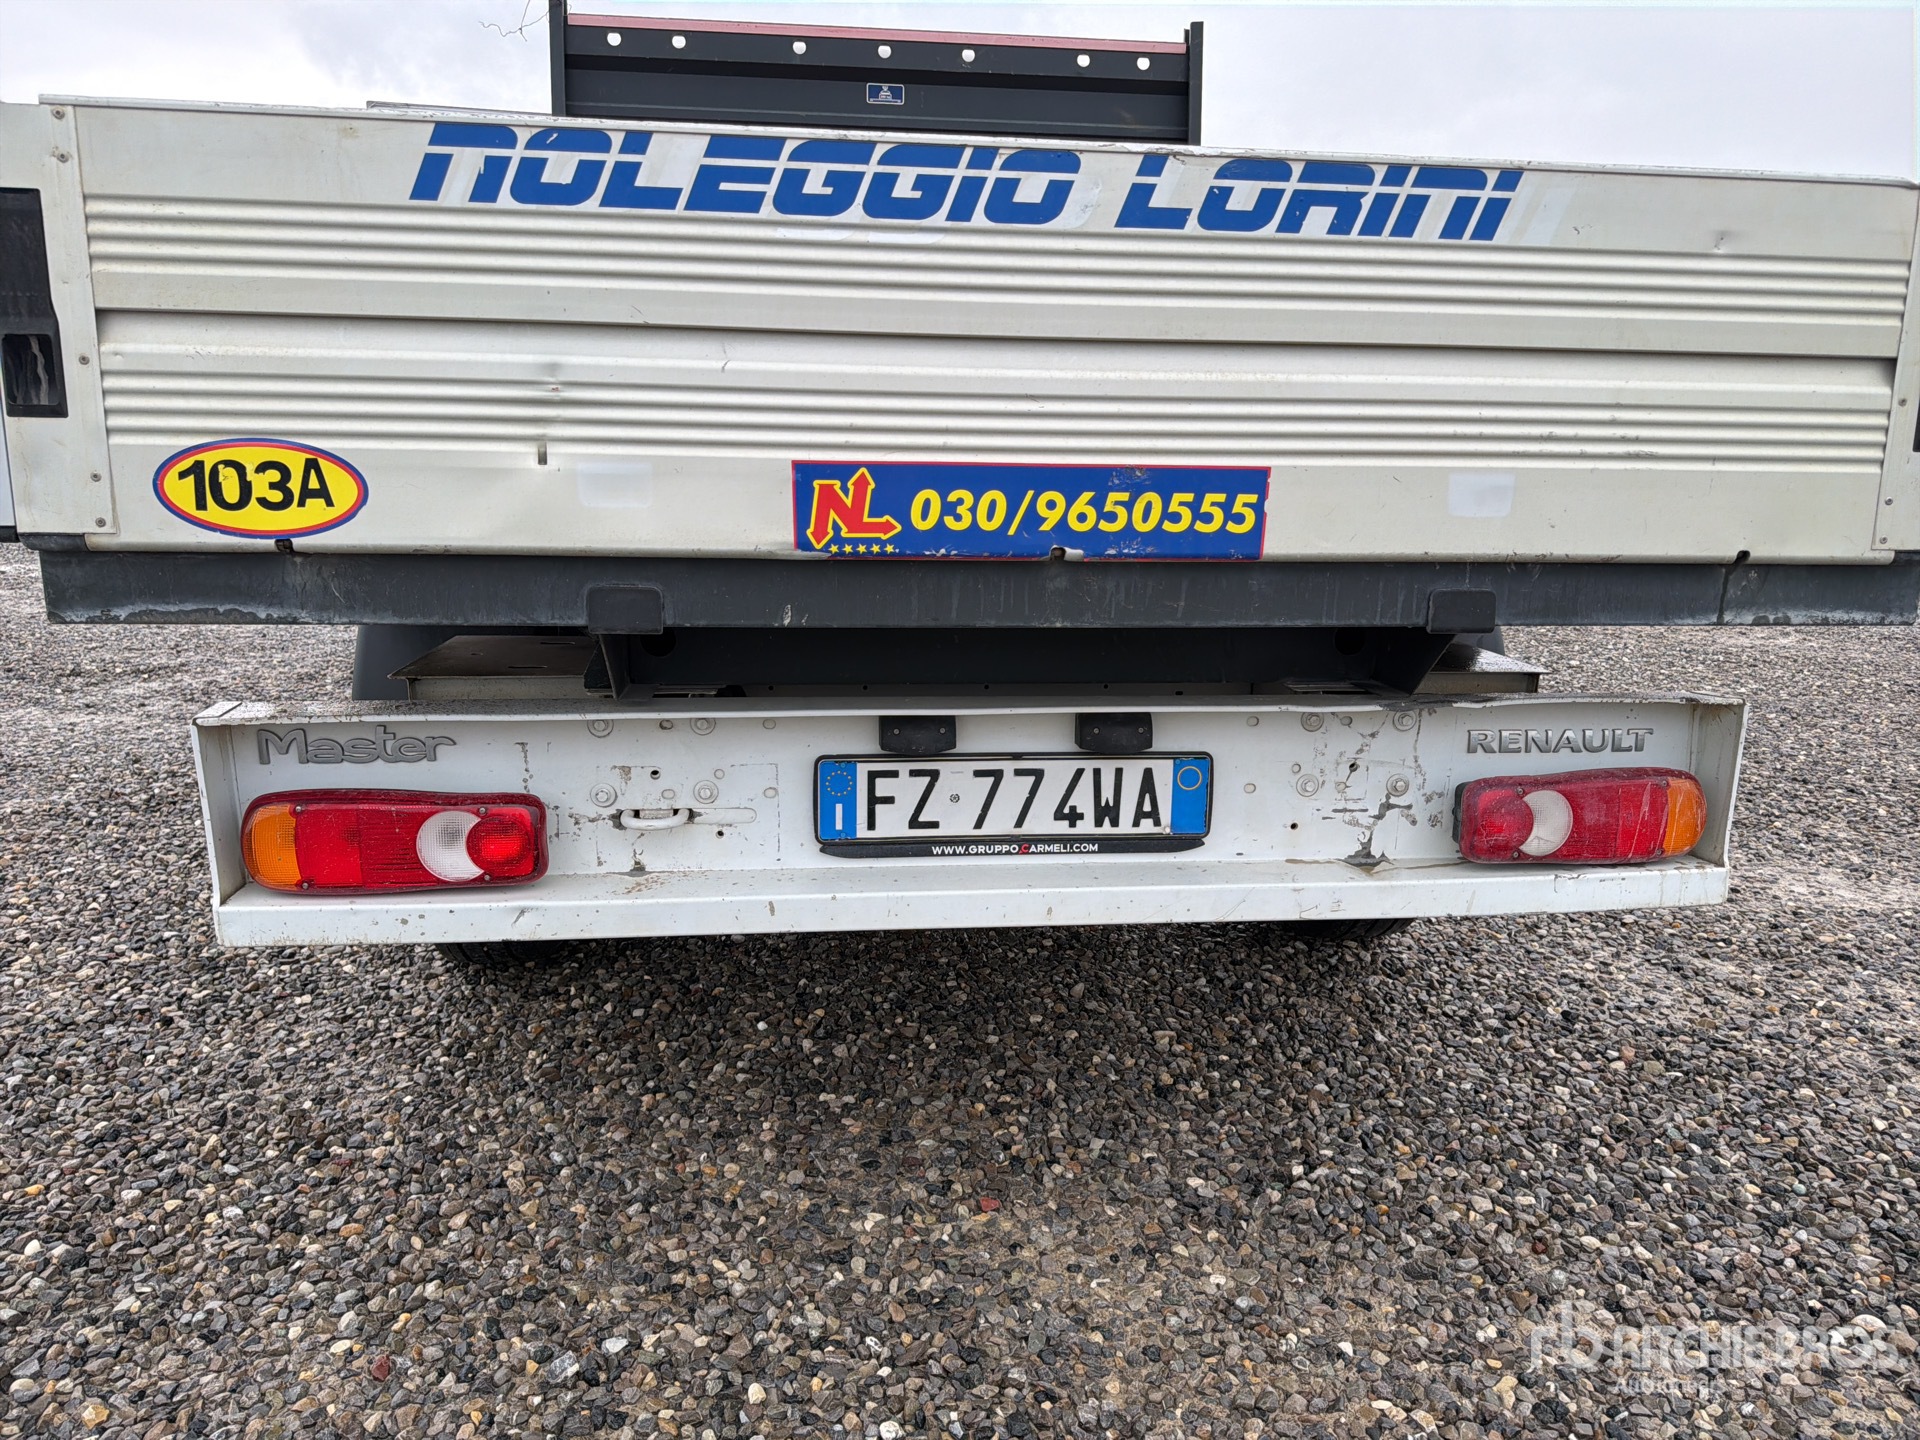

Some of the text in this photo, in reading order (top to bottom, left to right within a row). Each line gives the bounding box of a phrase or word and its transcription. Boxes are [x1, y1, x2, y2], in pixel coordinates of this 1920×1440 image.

[409, 122, 1524, 241] NOLEGGIO LORINI
[178, 457, 335, 511] 103A
[910, 489, 1258, 535] 030/9650555
[257, 725, 456, 765] Master
[1466, 728, 1654, 754] RENAULT
[931, 843, 1098, 856] WWW.GRUPPOCARMELI.COM
